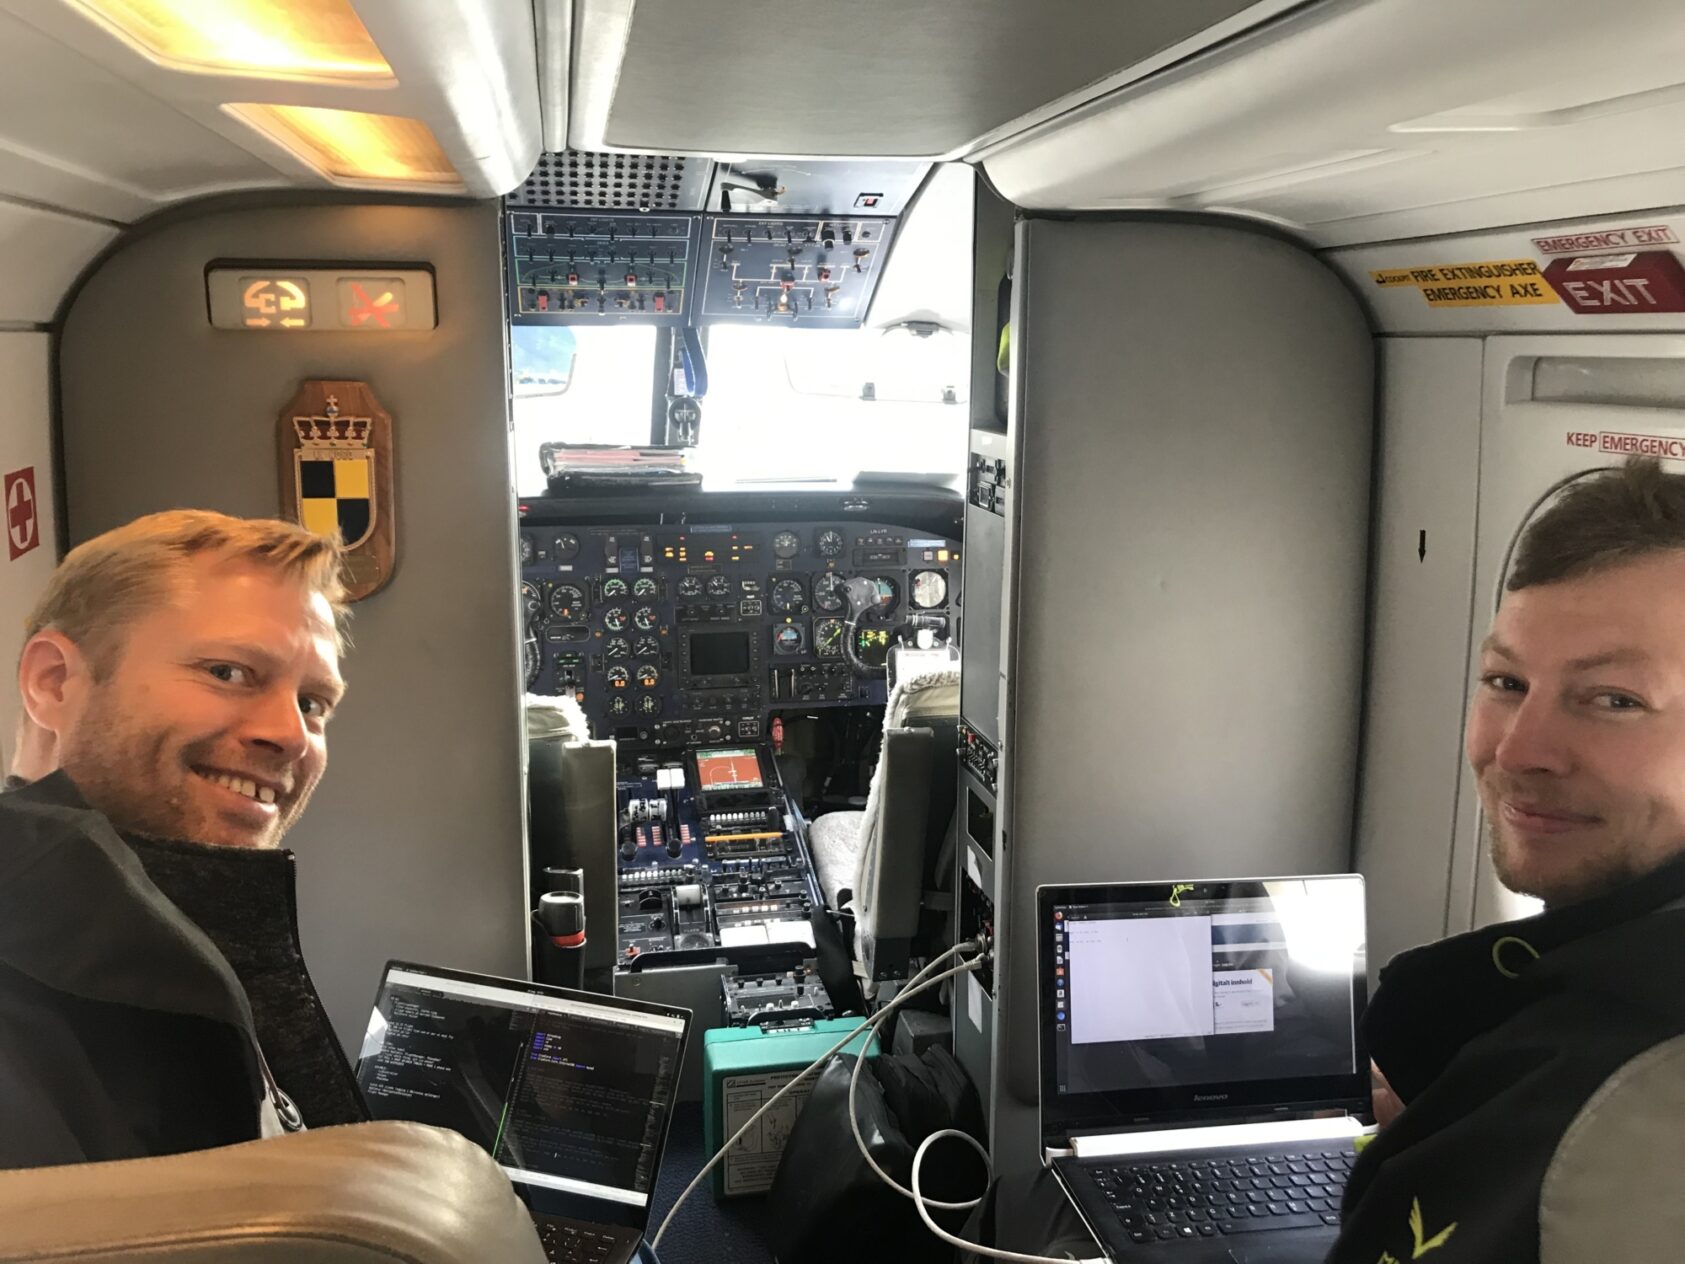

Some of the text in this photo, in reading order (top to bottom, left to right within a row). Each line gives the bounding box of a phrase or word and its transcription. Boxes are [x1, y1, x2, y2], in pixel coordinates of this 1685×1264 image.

[1536, 228, 1673, 252] EMERGENCY EXIT
[1410, 269, 1440, 282] FIRE
[1438, 262, 1541, 281] EXTINGUISHER
[1423, 283, 1543, 302] EMERGENCY AXE
[1562, 278, 1657, 306] EXIT
[1566, 432, 1685, 457] KEEP EMERGENCY
